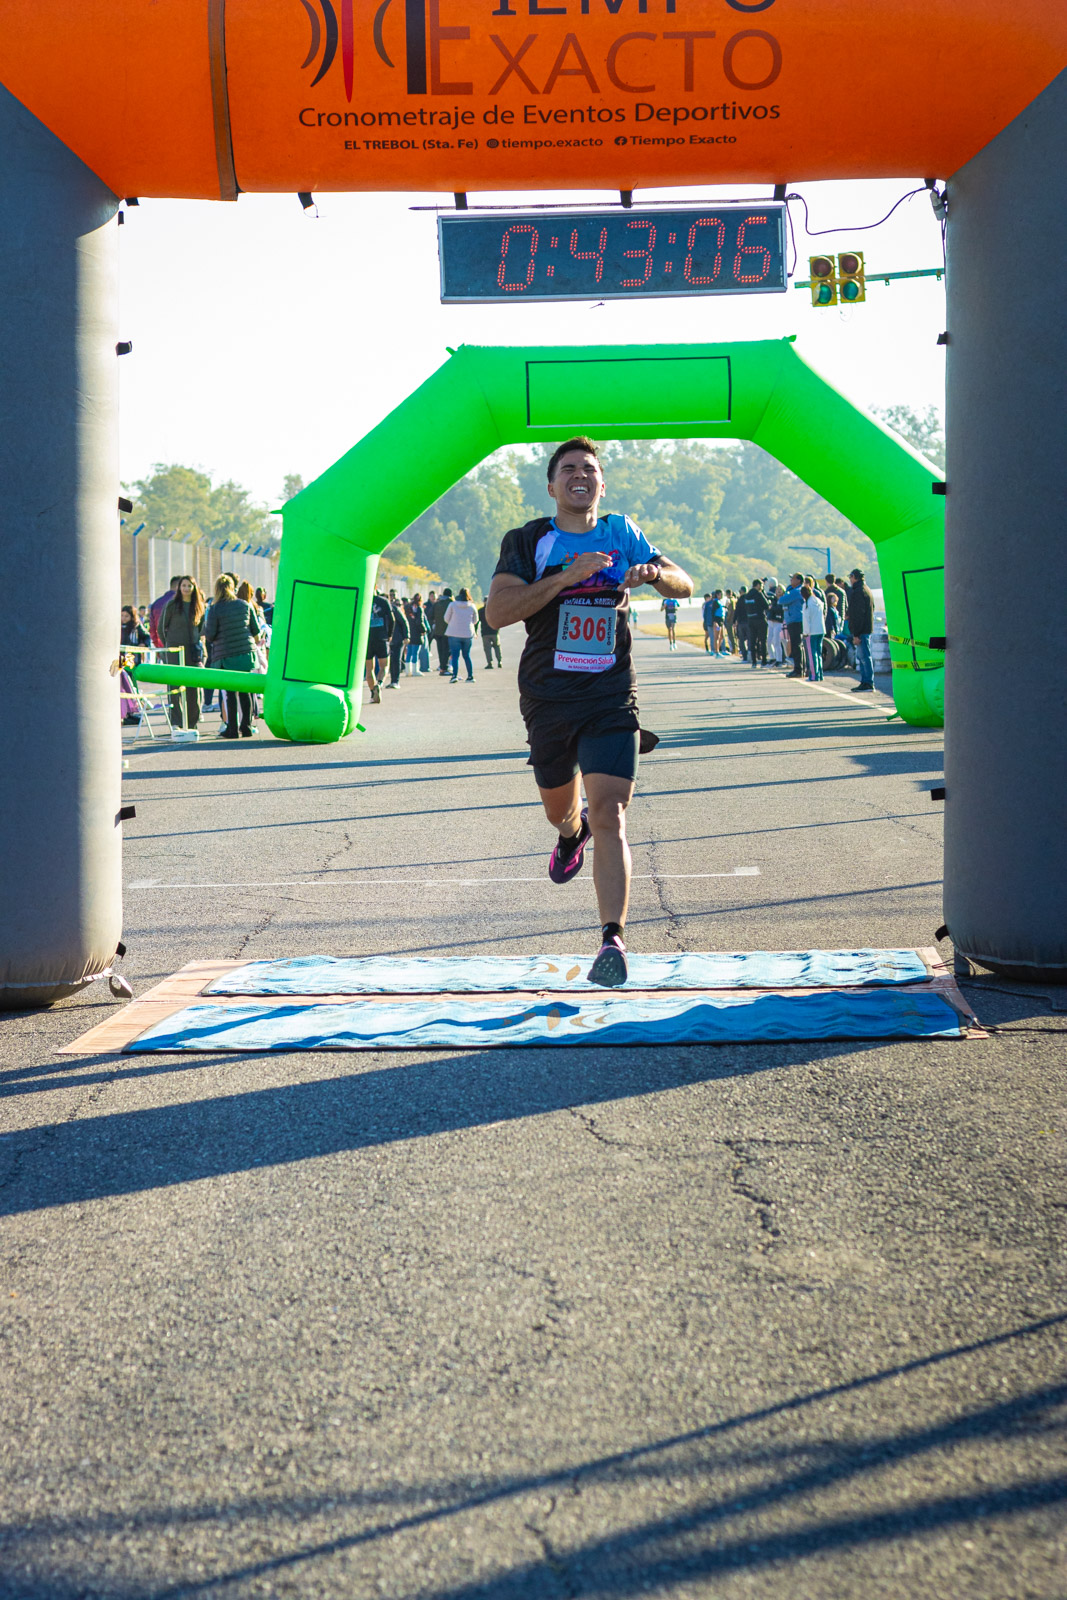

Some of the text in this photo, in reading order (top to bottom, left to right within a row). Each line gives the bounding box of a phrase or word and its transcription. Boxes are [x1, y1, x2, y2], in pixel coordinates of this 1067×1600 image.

[299, 101, 780, 130] Cronometraje de Eventos Deportivos
[344, 134, 737, 151] EL TREBOL (Sta. Fe) tiempo.exacto Tiempo Exacto
[497, 216, 771, 291] 0:43:06
[562, 612, 570, 640] TIEMPO
[568, 616, 606, 641] 306
